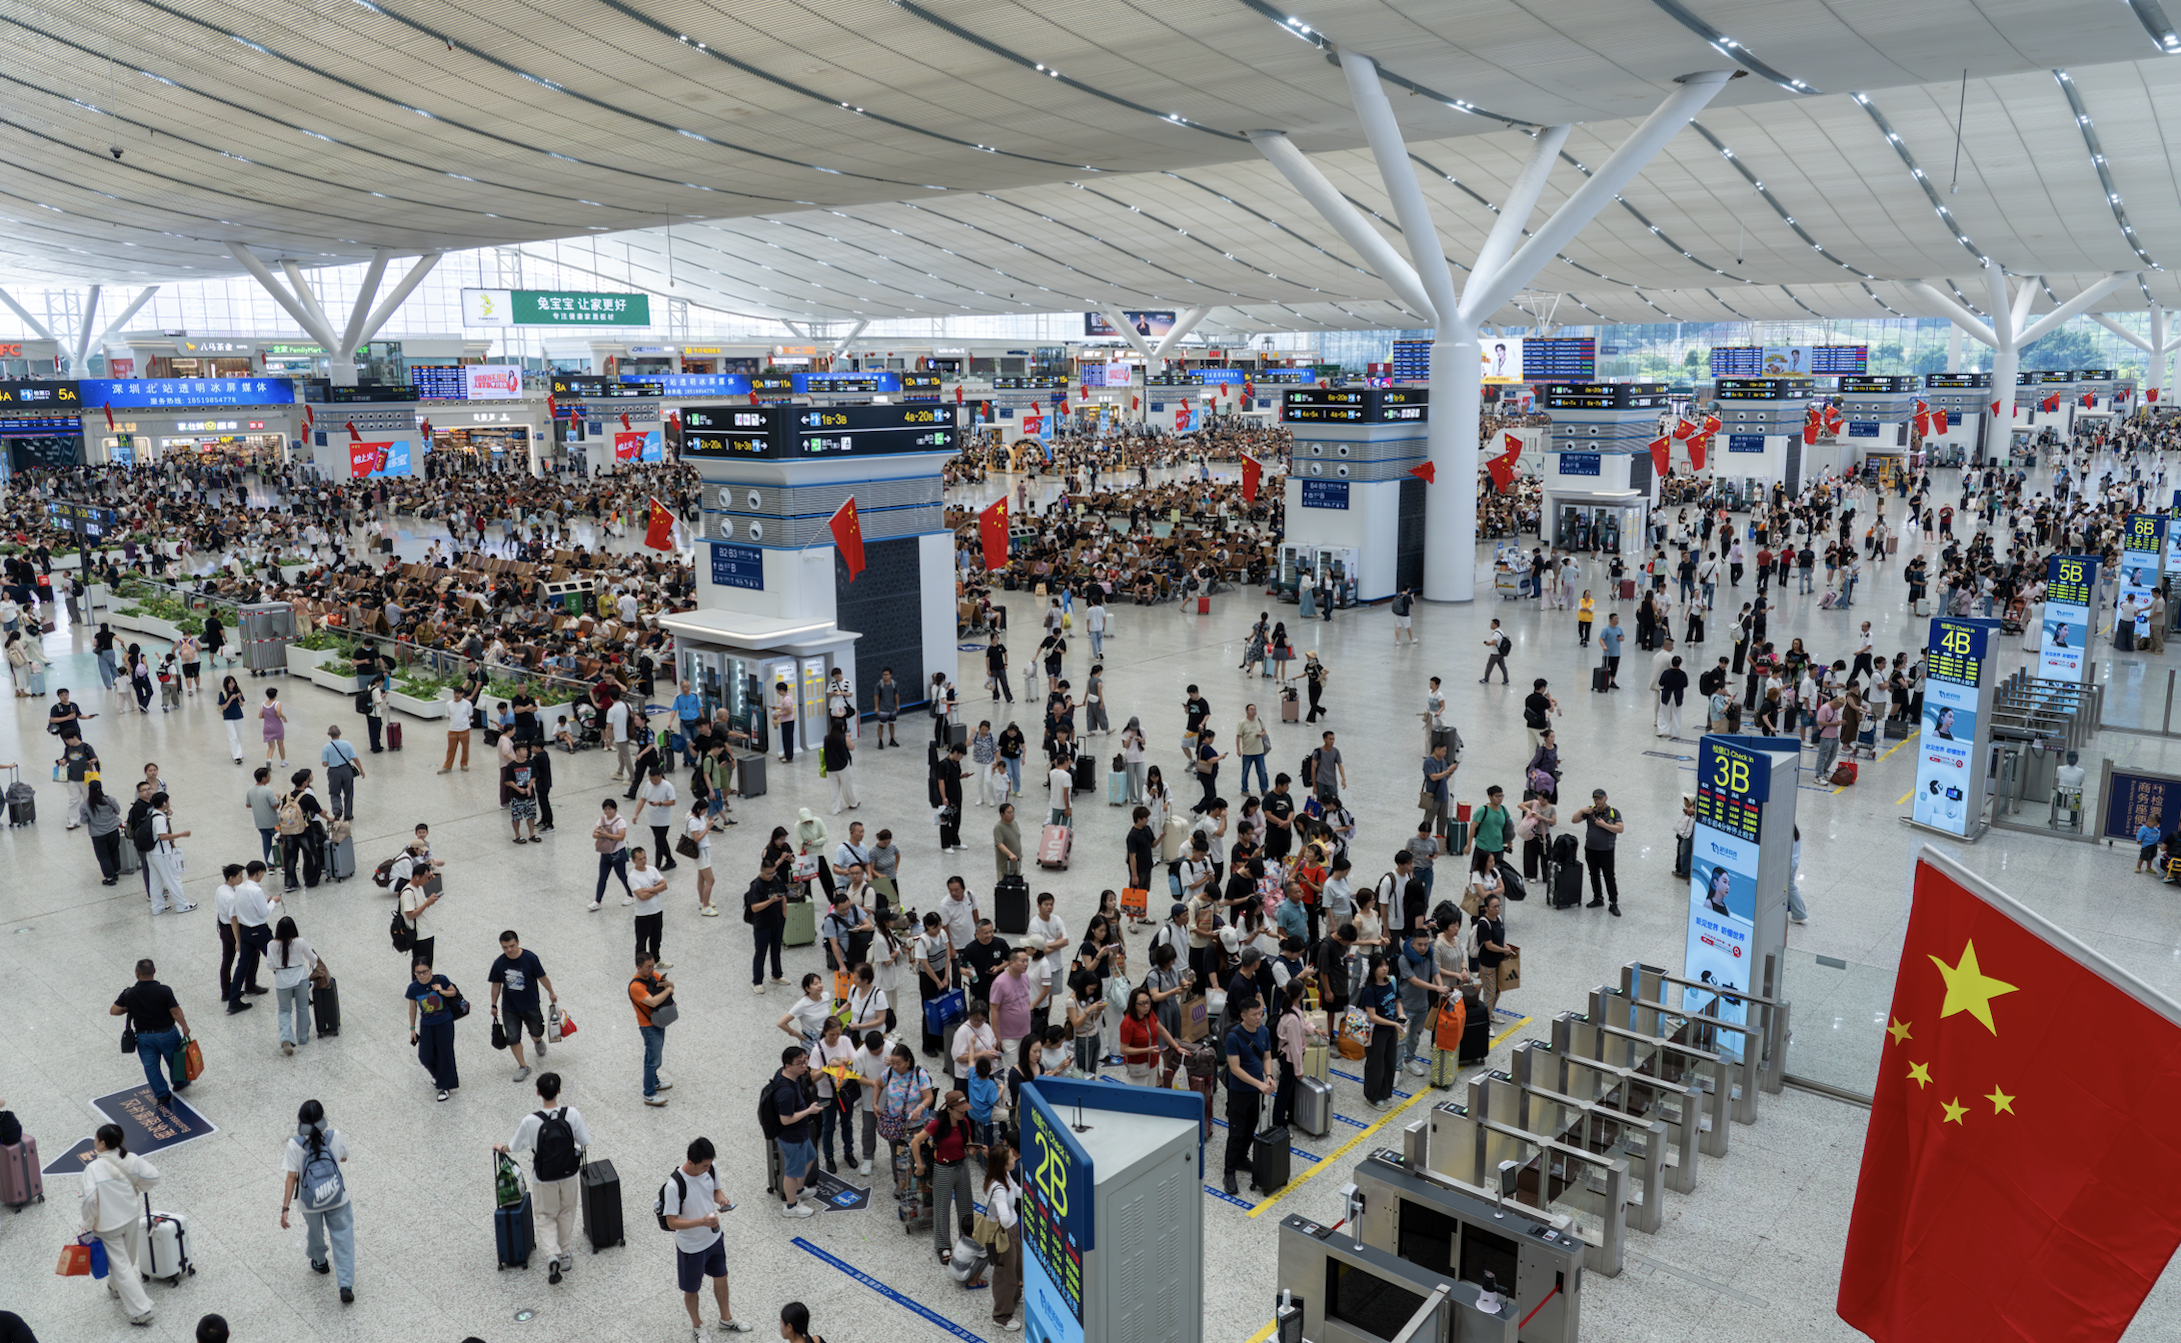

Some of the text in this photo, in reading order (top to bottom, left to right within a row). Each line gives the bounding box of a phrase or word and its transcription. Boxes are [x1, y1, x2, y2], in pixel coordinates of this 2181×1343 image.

[537, 296, 626, 312] 兔宝宝 让家更好
[0, 344, 21, 356] FC
[200, 343, 233, 352] 八马茶业
[289, 347, 322, 355] FamilyMart
[112, 381, 267, 395] 深圳北站透明冰屏媒体
[554, 382, 567, 392] 8A
[751, 379, 764, 389] 10A
[905, 376, 916, 386] 12A
[930, 376, 941, 386] 13A
[58, 388, 77, 401] 5A
[353, 452, 374, 465] 怕上火
[2134, 521, 2155, 536] 6B
[2059, 564, 2083, 583] 5B
[1941, 630, 1971, 655] 4B
[1730, 750, 1749, 761] Check
[1749, 756, 1755, 764] in
[1714, 755, 1751, 794] 3B
[156, 1103, 192, 1134] Business Class
[1048, 1130, 1065, 1159] Check
[1035, 1131, 1068, 1218] 2B
